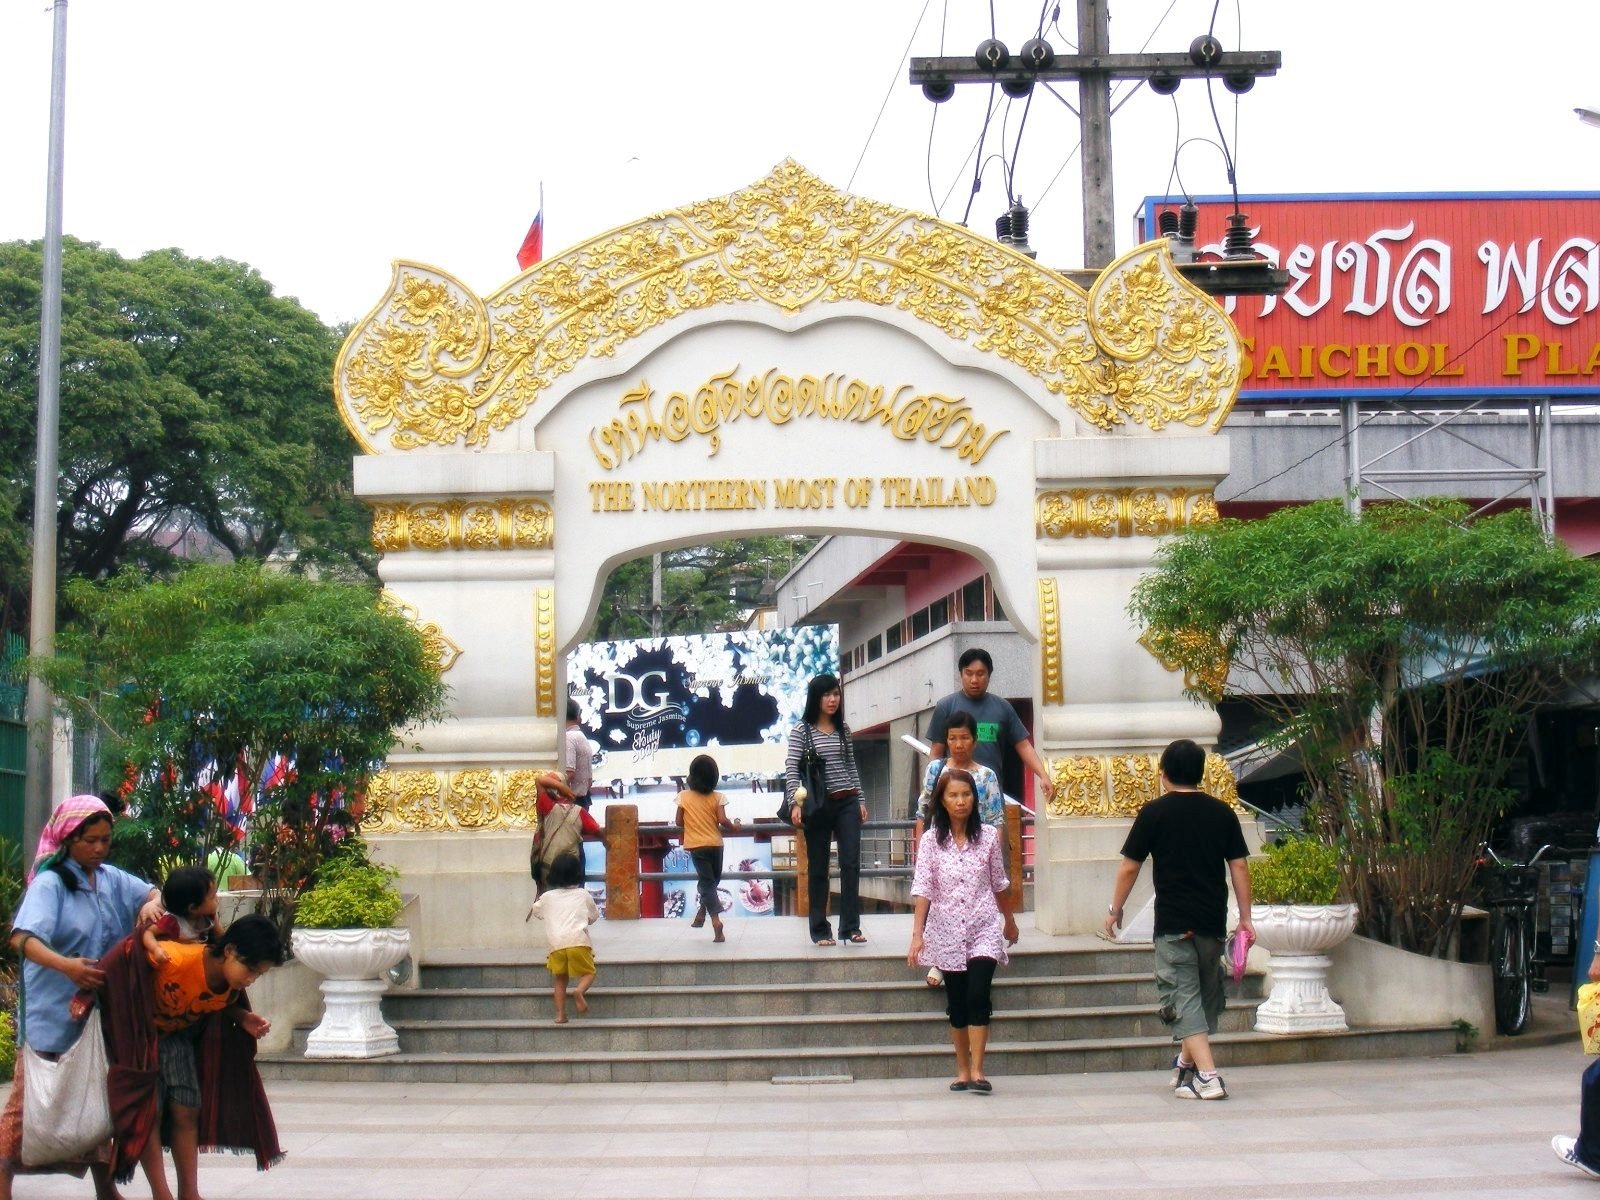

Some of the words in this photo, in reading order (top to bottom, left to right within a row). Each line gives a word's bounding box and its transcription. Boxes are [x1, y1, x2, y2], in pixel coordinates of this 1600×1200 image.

[588, 480, 635, 512] THE
[641, 479, 767, 511] NORTHERN
[773, 478, 836, 509] MOST
[843, 476, 872, 508] OF
[879, 475, 997, 508] THAILAND
[604, 671, 670, 714] DG
[683, 676, 723, 692] Supreme
[626, 719, 657, 731] Supreme
[657, 712, 687, 724] Jasmine
